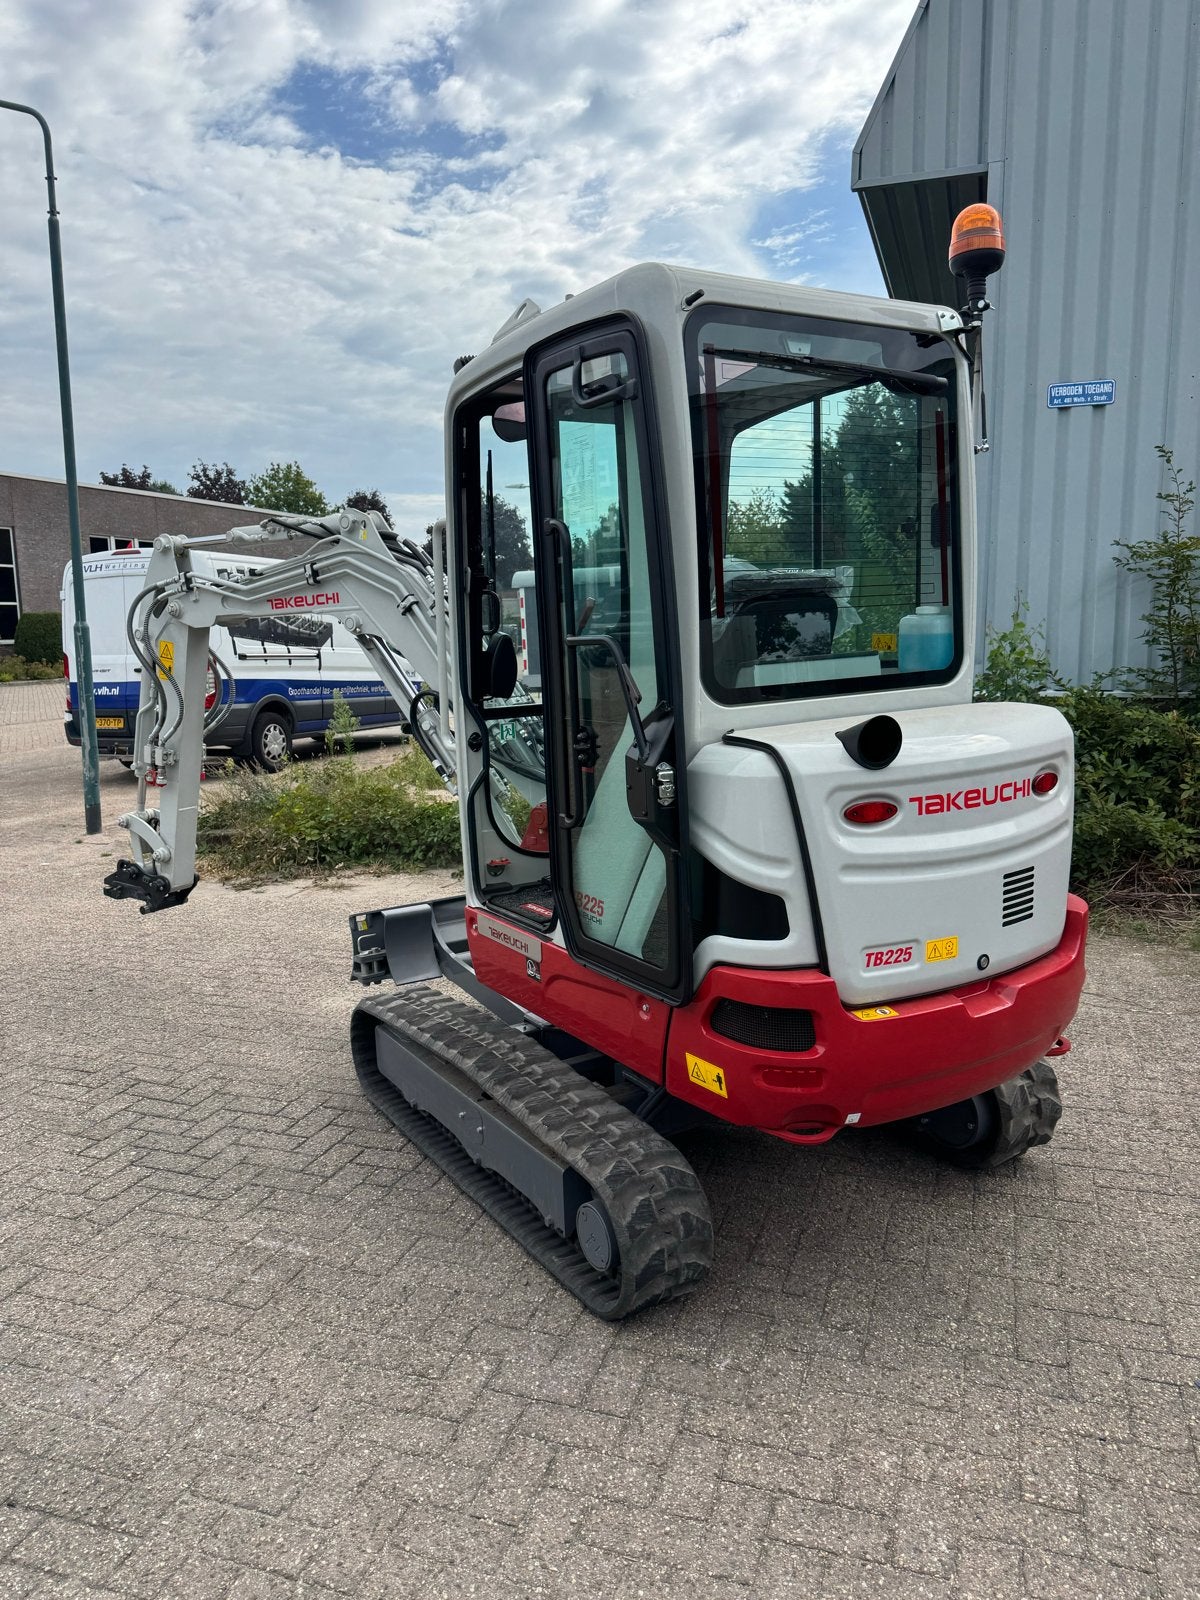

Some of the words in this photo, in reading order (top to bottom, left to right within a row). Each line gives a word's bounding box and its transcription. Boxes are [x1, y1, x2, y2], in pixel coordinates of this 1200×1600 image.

[1051, 385, 1083, 397] VERBODEN
[1084, 383, 1112, 394] TOEGANG
[83, 563, 103, 573] VLH
[266, 592, 340, 610] TAKEUCHI
[288, 686, 321, 696] Groothandel
[96, 719, 122, 727] -370-TP
[908, 778, 1031, 816] TAKEUCHI
[488, 926, 529, 954] TAKEUCHI
[865, 946, 913, 968] TB225
